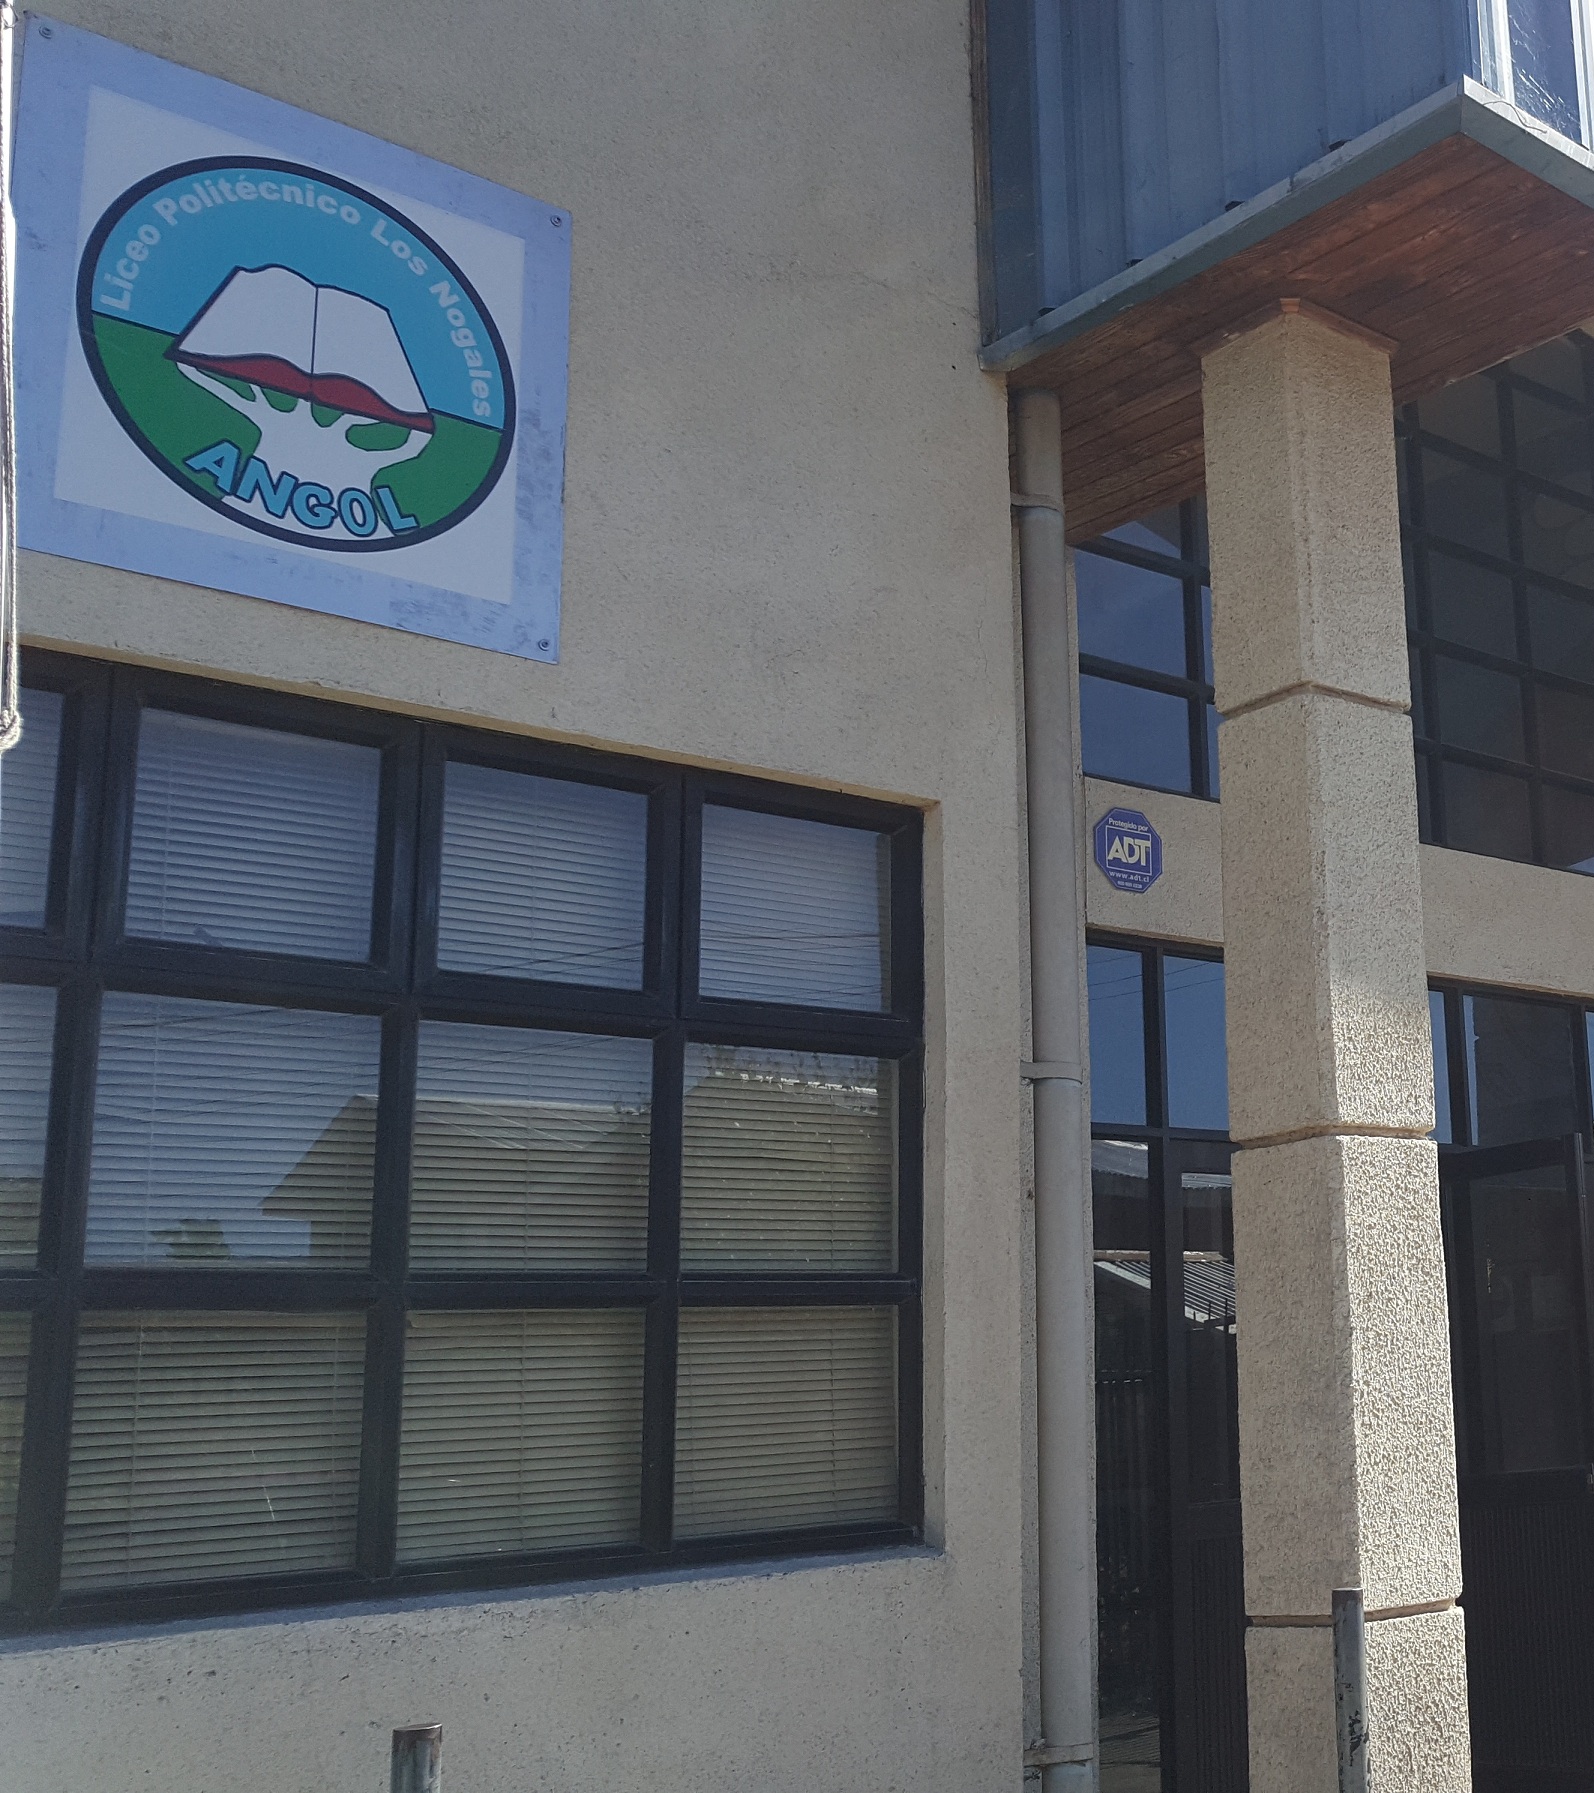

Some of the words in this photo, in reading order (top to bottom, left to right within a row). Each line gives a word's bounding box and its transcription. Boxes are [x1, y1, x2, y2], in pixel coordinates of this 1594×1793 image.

[100, 223, 162, 311] Liceo
[152, 173, 363, 226] Politécnico
[370, 217, 428, 276] Los
[428, 279, 494, 418] Nogales
[183, 439, 420, 537] ANGOL
[1108, 818, 1137, 829] Protegido
[1107, 835, 1151, 866] ADT
[1109, 871, 1150, 883] www.adt.cl
